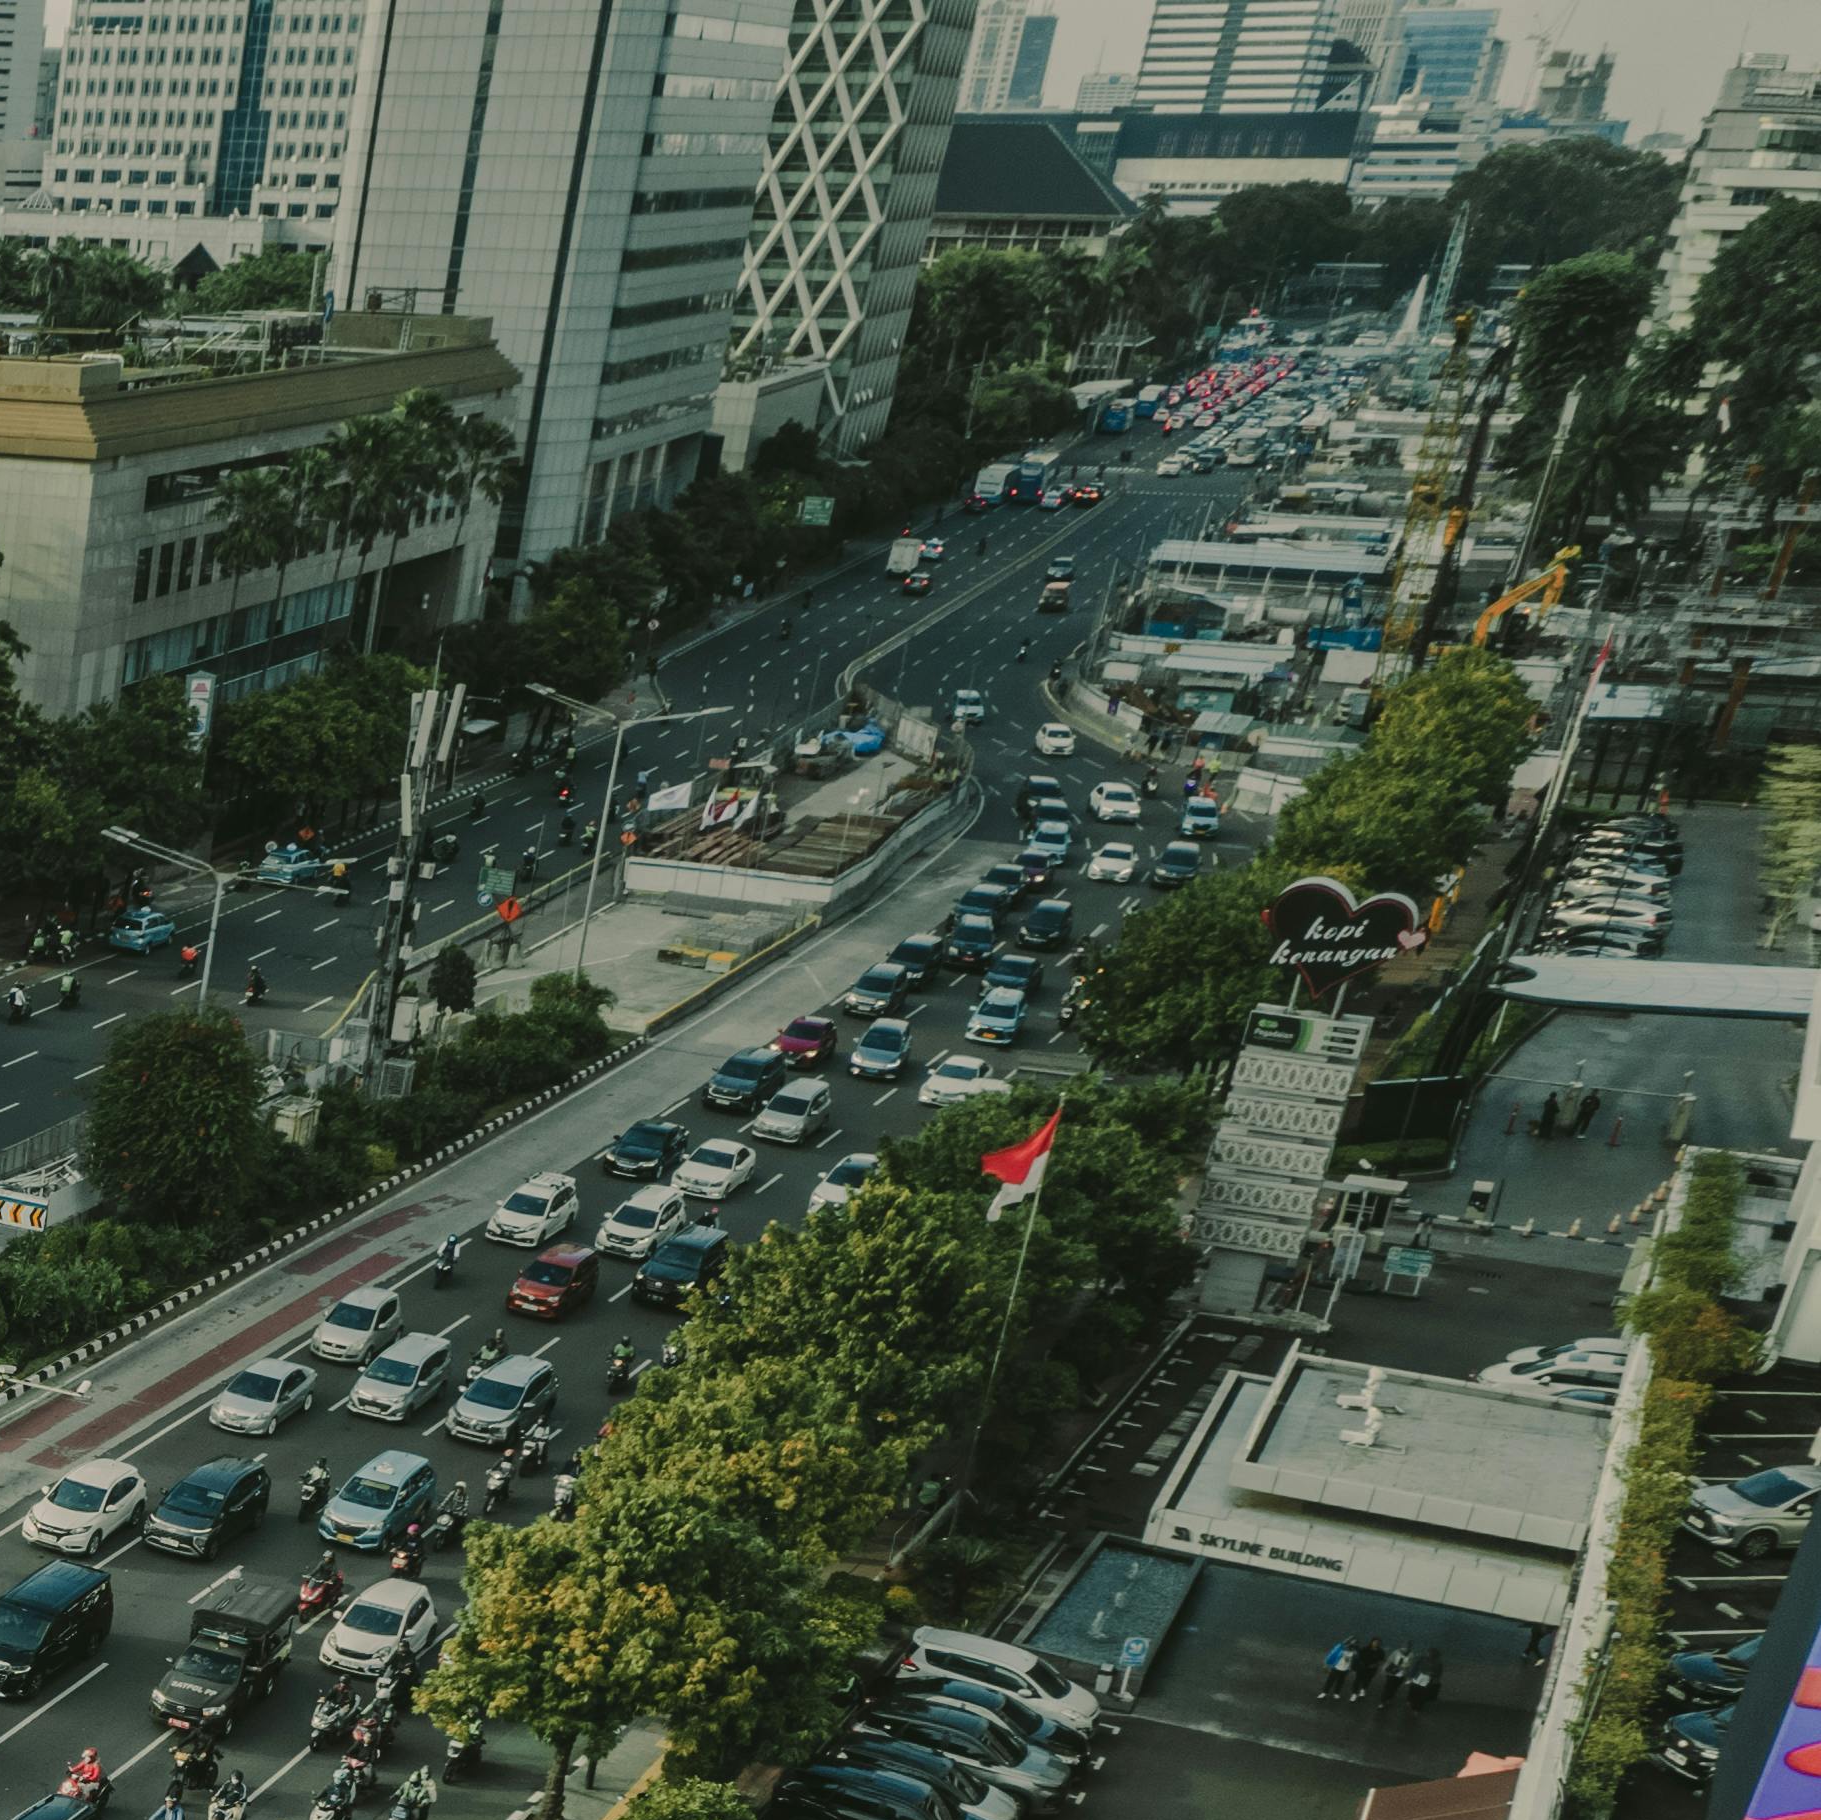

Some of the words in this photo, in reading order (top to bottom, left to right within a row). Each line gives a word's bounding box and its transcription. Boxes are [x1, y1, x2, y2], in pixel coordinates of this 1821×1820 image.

[1304, 915, 1370, 942] kopi
[1269, 939, 1397, 967] kenangan
[1198, 1533, 1265, 1557] SKYLINE
[1269, 1547, 1344, 1572] BUILDING
[171, 1680, 204, 1695] SATPOL
